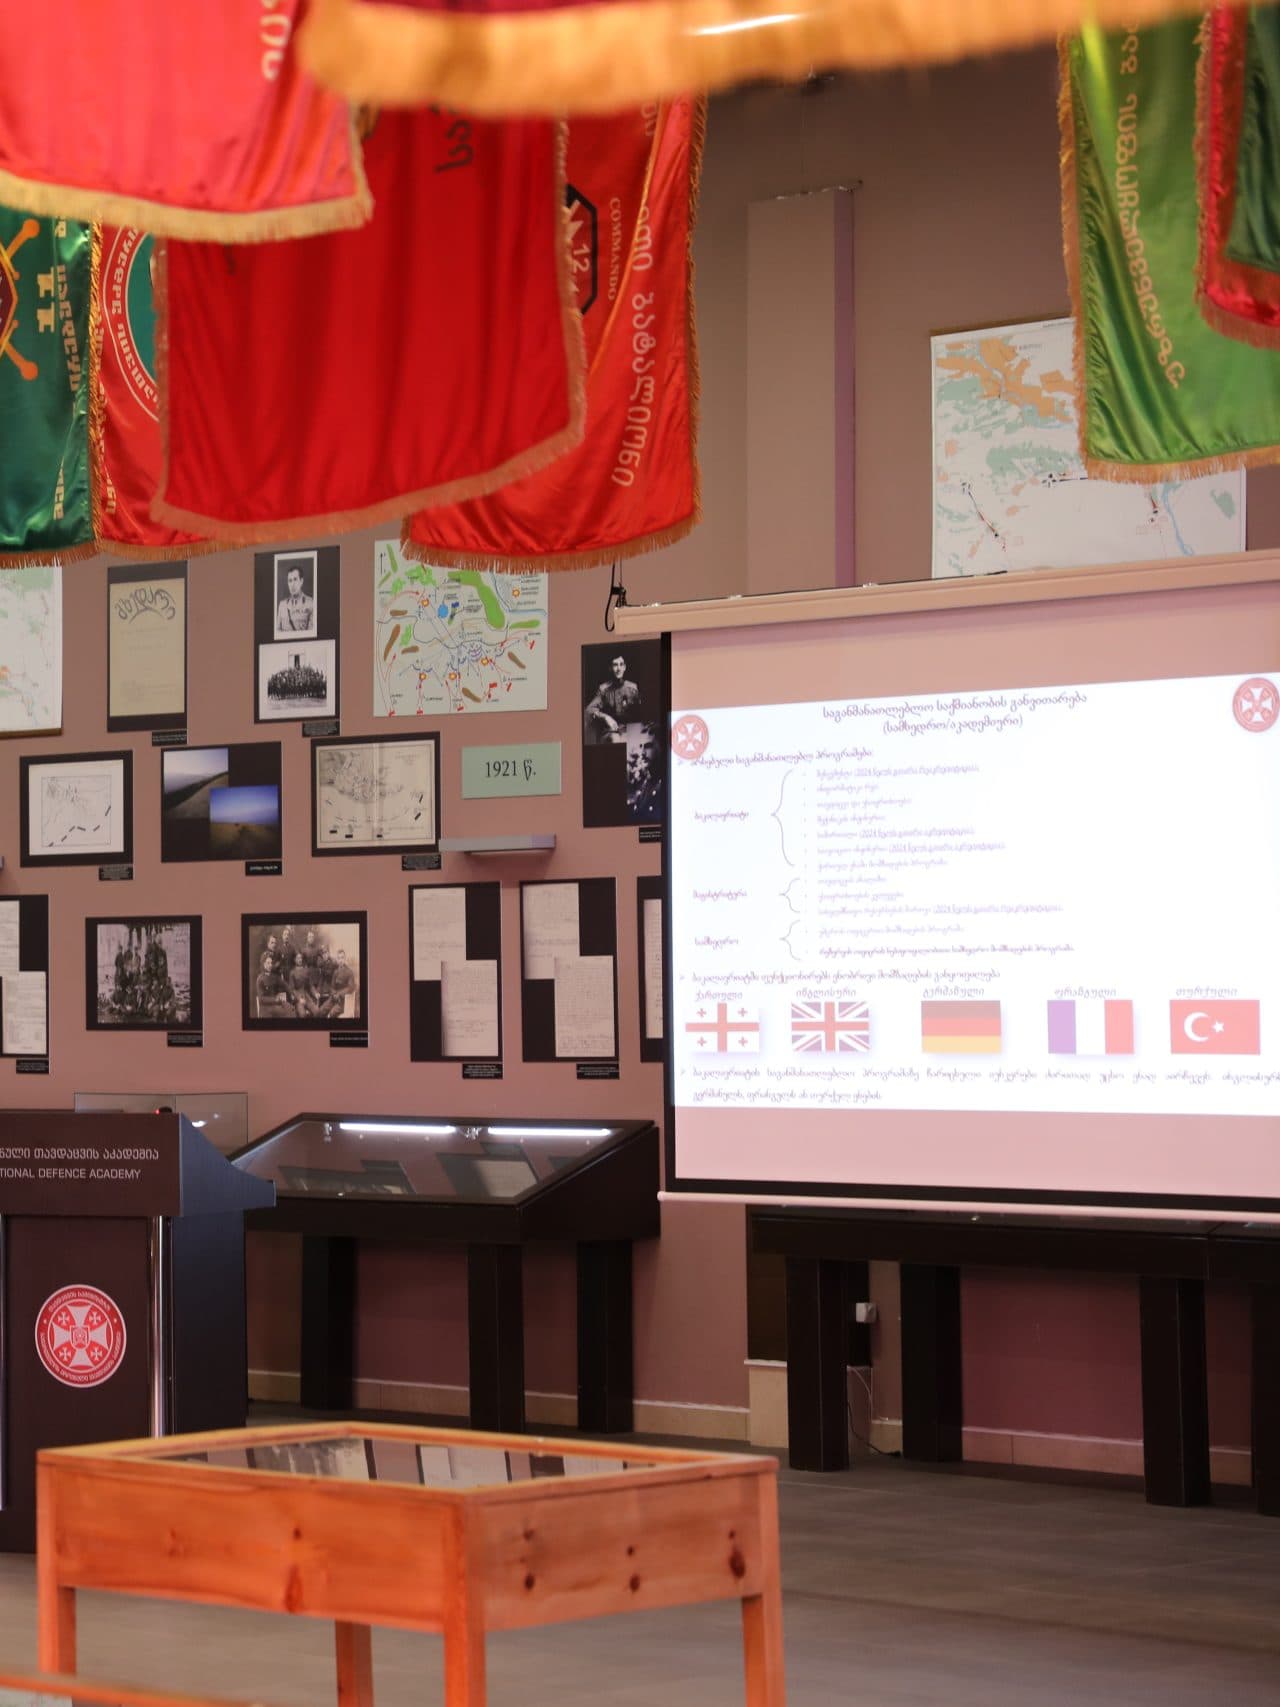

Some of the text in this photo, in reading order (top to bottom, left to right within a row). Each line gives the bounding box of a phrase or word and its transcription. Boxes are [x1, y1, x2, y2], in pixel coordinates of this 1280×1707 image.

[572, 244, 590, 273] 12
[606, 197, 622, 300] COMMANDO
[610, 292, 658, 487] ბატალიონი
[823, 691, 1088, 723] საგანმანათლებლო საქმიანობის განვითარება
[485, 760, 518, 778] 1921
[34, 1147, 99, 1159] თავდაცვის
[103, 1148, 159, 1160] აკადემია
[38, 1168, 86, 1178] DEFENCE
[89, 1168, 141, 1179] ACADEMY
